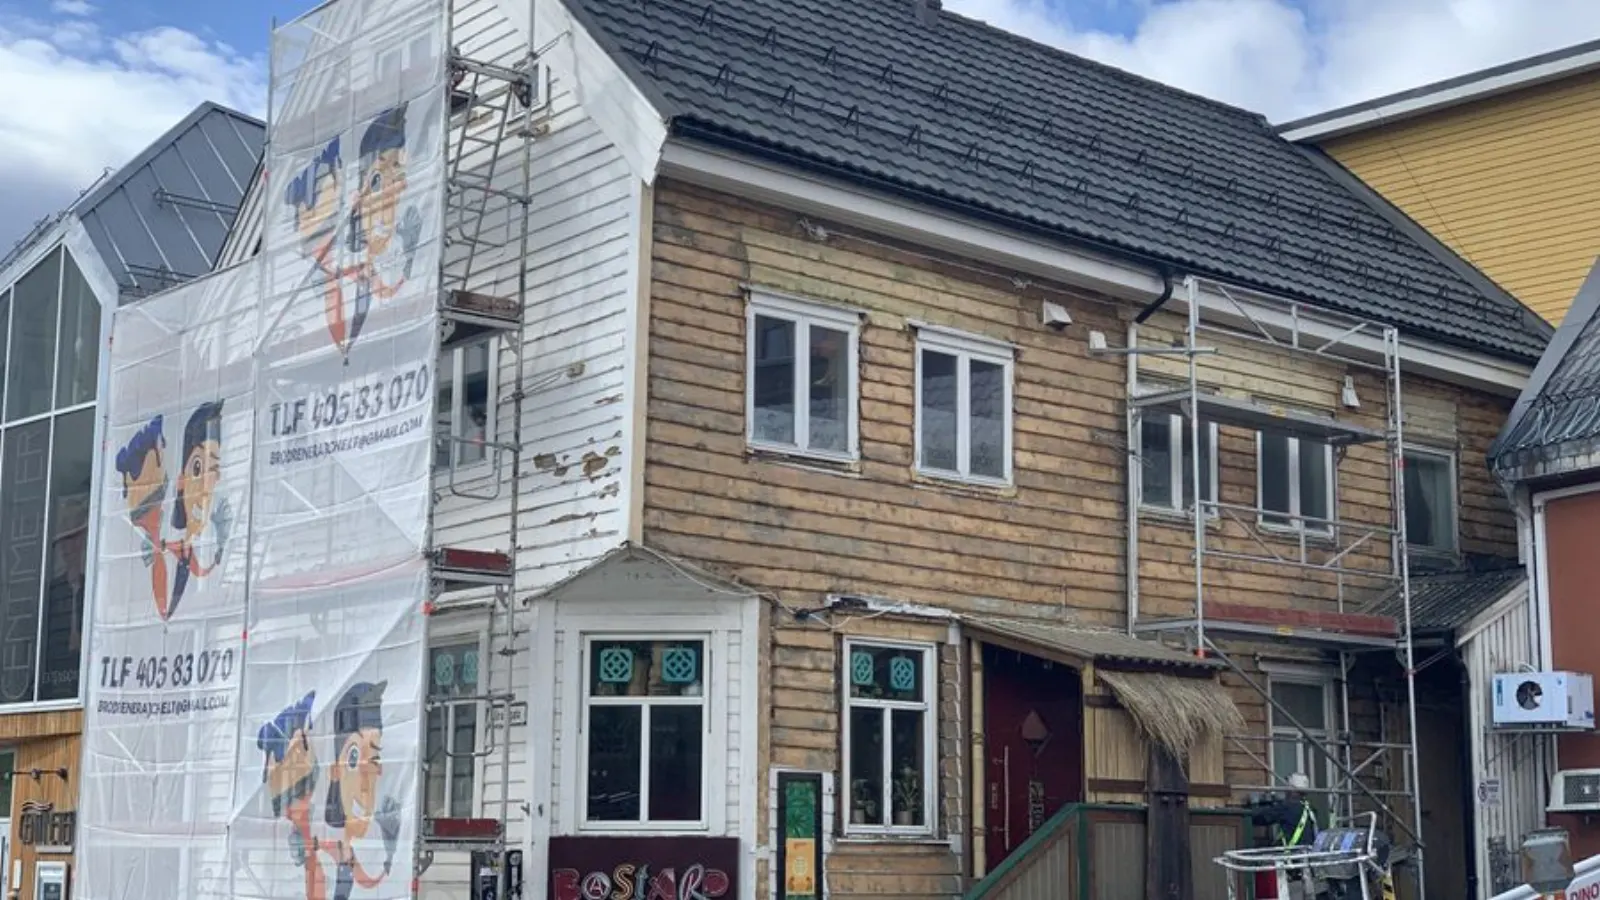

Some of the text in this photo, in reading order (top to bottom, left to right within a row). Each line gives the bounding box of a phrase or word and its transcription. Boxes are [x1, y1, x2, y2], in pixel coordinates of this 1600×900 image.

[269, 364, 429, 437] TLF 405 83 070
[1, 430, 44, 700] CENTIMETER
[101, 656, 133, 688] TLF
[136, 655, 168, 689] 405
[171, 653, 194, 687] 83
[197, 647, 234, 684] 070
[1570, 881, 1600, 900] DINO
